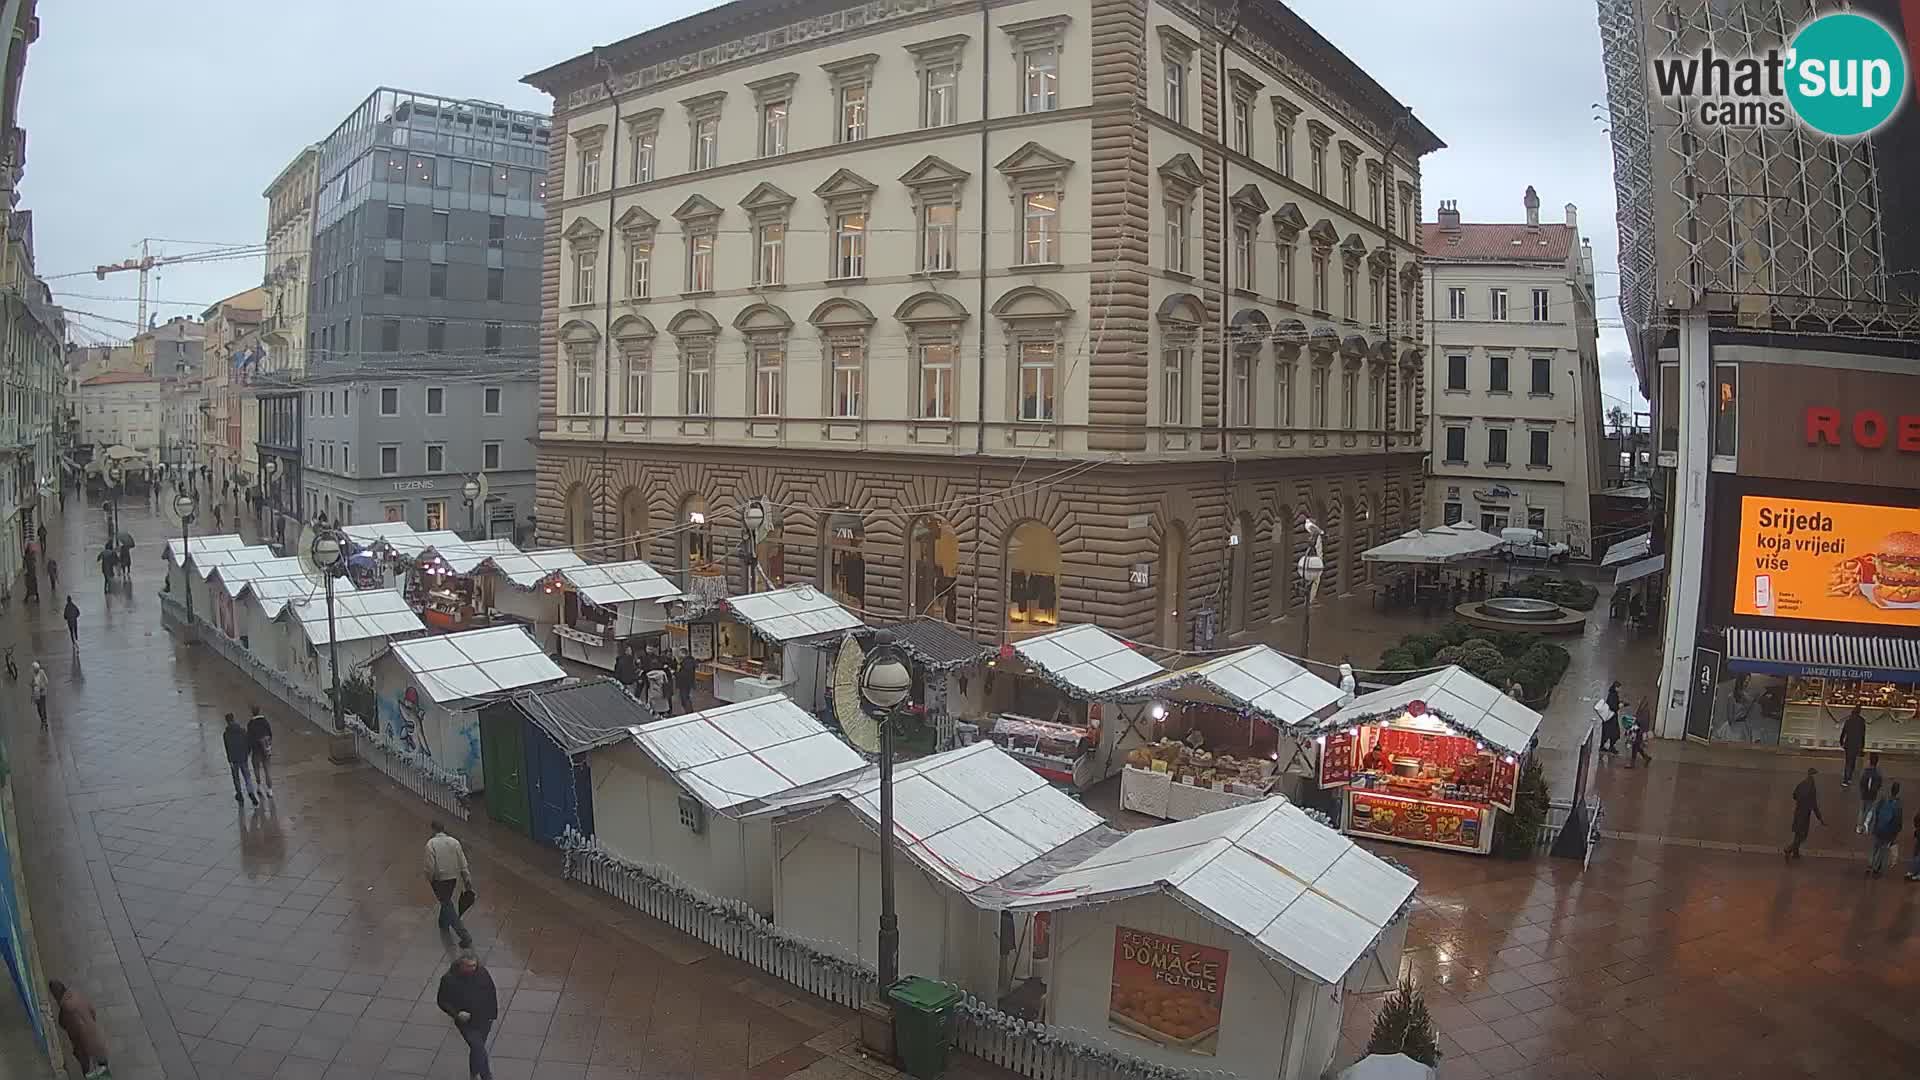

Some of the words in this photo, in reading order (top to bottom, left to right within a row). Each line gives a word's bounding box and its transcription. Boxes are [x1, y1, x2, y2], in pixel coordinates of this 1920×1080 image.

[392, 479, 434, 490] TEZENIS
[1759, 507, 1833, 534] Srijeda
[1757, 533, 1791, 553] koja
[1795, 536, 1846, 556] vrijedi
[1756, 553, 1789, 571] više
[1122, 943, 1219, 981] DOMAĆE
[1156, 971, 1217, 993] FRITULE
